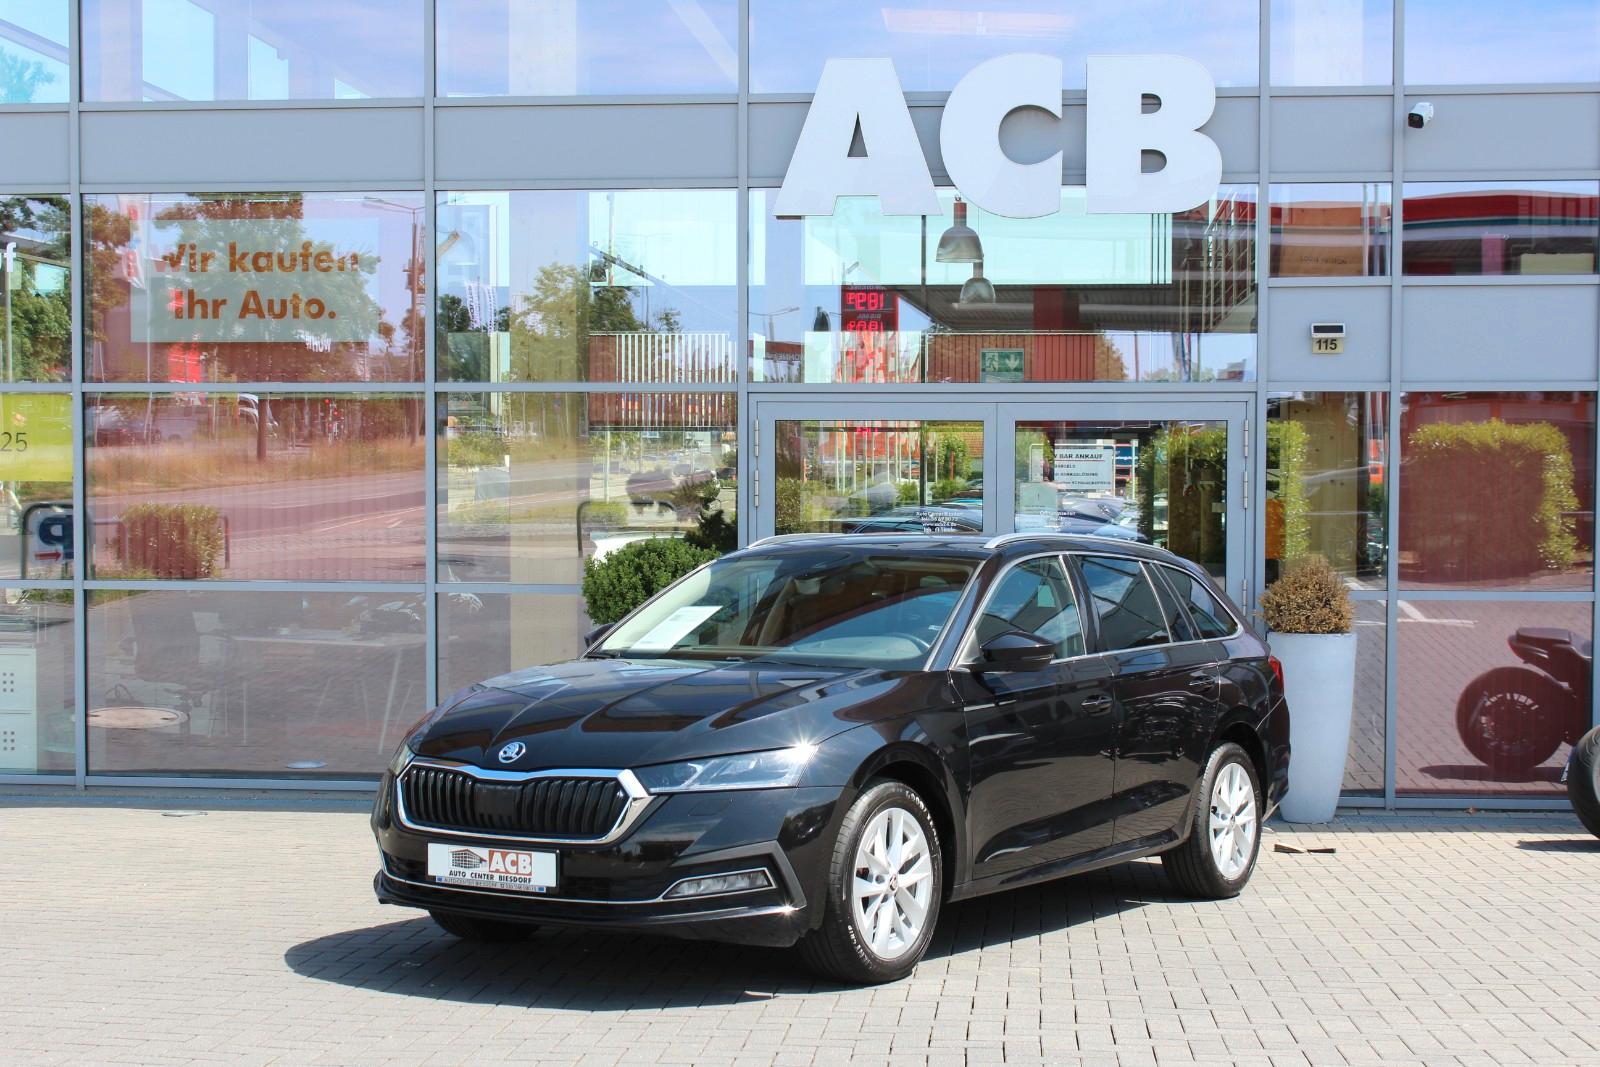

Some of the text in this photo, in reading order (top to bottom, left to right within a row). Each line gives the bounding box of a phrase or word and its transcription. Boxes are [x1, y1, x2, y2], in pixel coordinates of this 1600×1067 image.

[773, 53, 1223, 219] ACB
[149, 241, 359, 273] Wir kaufen
[174, 289, 337, 320] Ihr Auto.
[1316, 338, 1338, 351] 115
[0, 431, 28, 453] 25
[490, 850, 532, 874] ACB
[449, 869, 533, 884] AUTO CENTER BIESDORF
